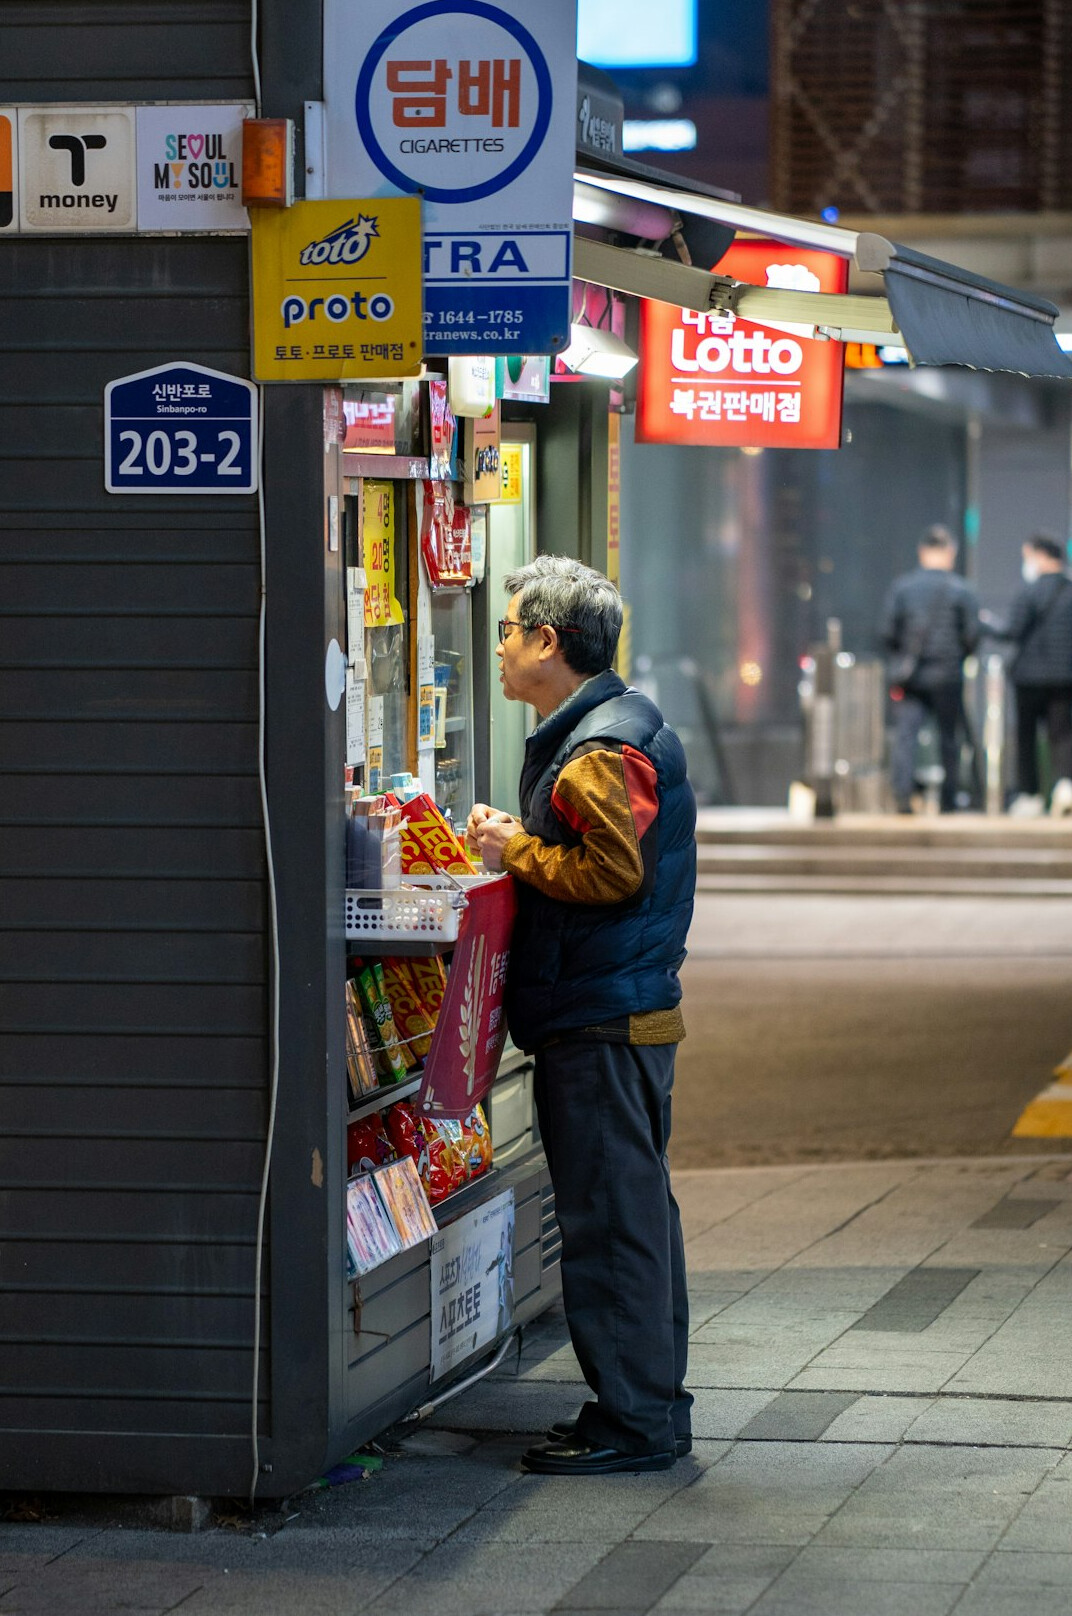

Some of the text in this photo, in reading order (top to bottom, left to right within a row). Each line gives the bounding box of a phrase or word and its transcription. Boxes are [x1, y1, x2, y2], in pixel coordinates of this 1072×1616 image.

[386, 59, 521, 128] 담배
[400, 138, 504, 154] CIGARETTES
[40, 194, 118, 213] money
[299, 229, 371, 266] toto
[280, 291, 396, 329] proto
[438, 310, 524, 325] 1644-1785
[359, 342, 404, 361] 판매점
[671, 328, 803, 375] Lotto
[152, 383, 212, 401] 신반포로
[156, 405, 208, 415] Sinbanpo-ro
[669, 389, 802, 423] 복권판매점
[118, 430, 242, 476] 203-2
